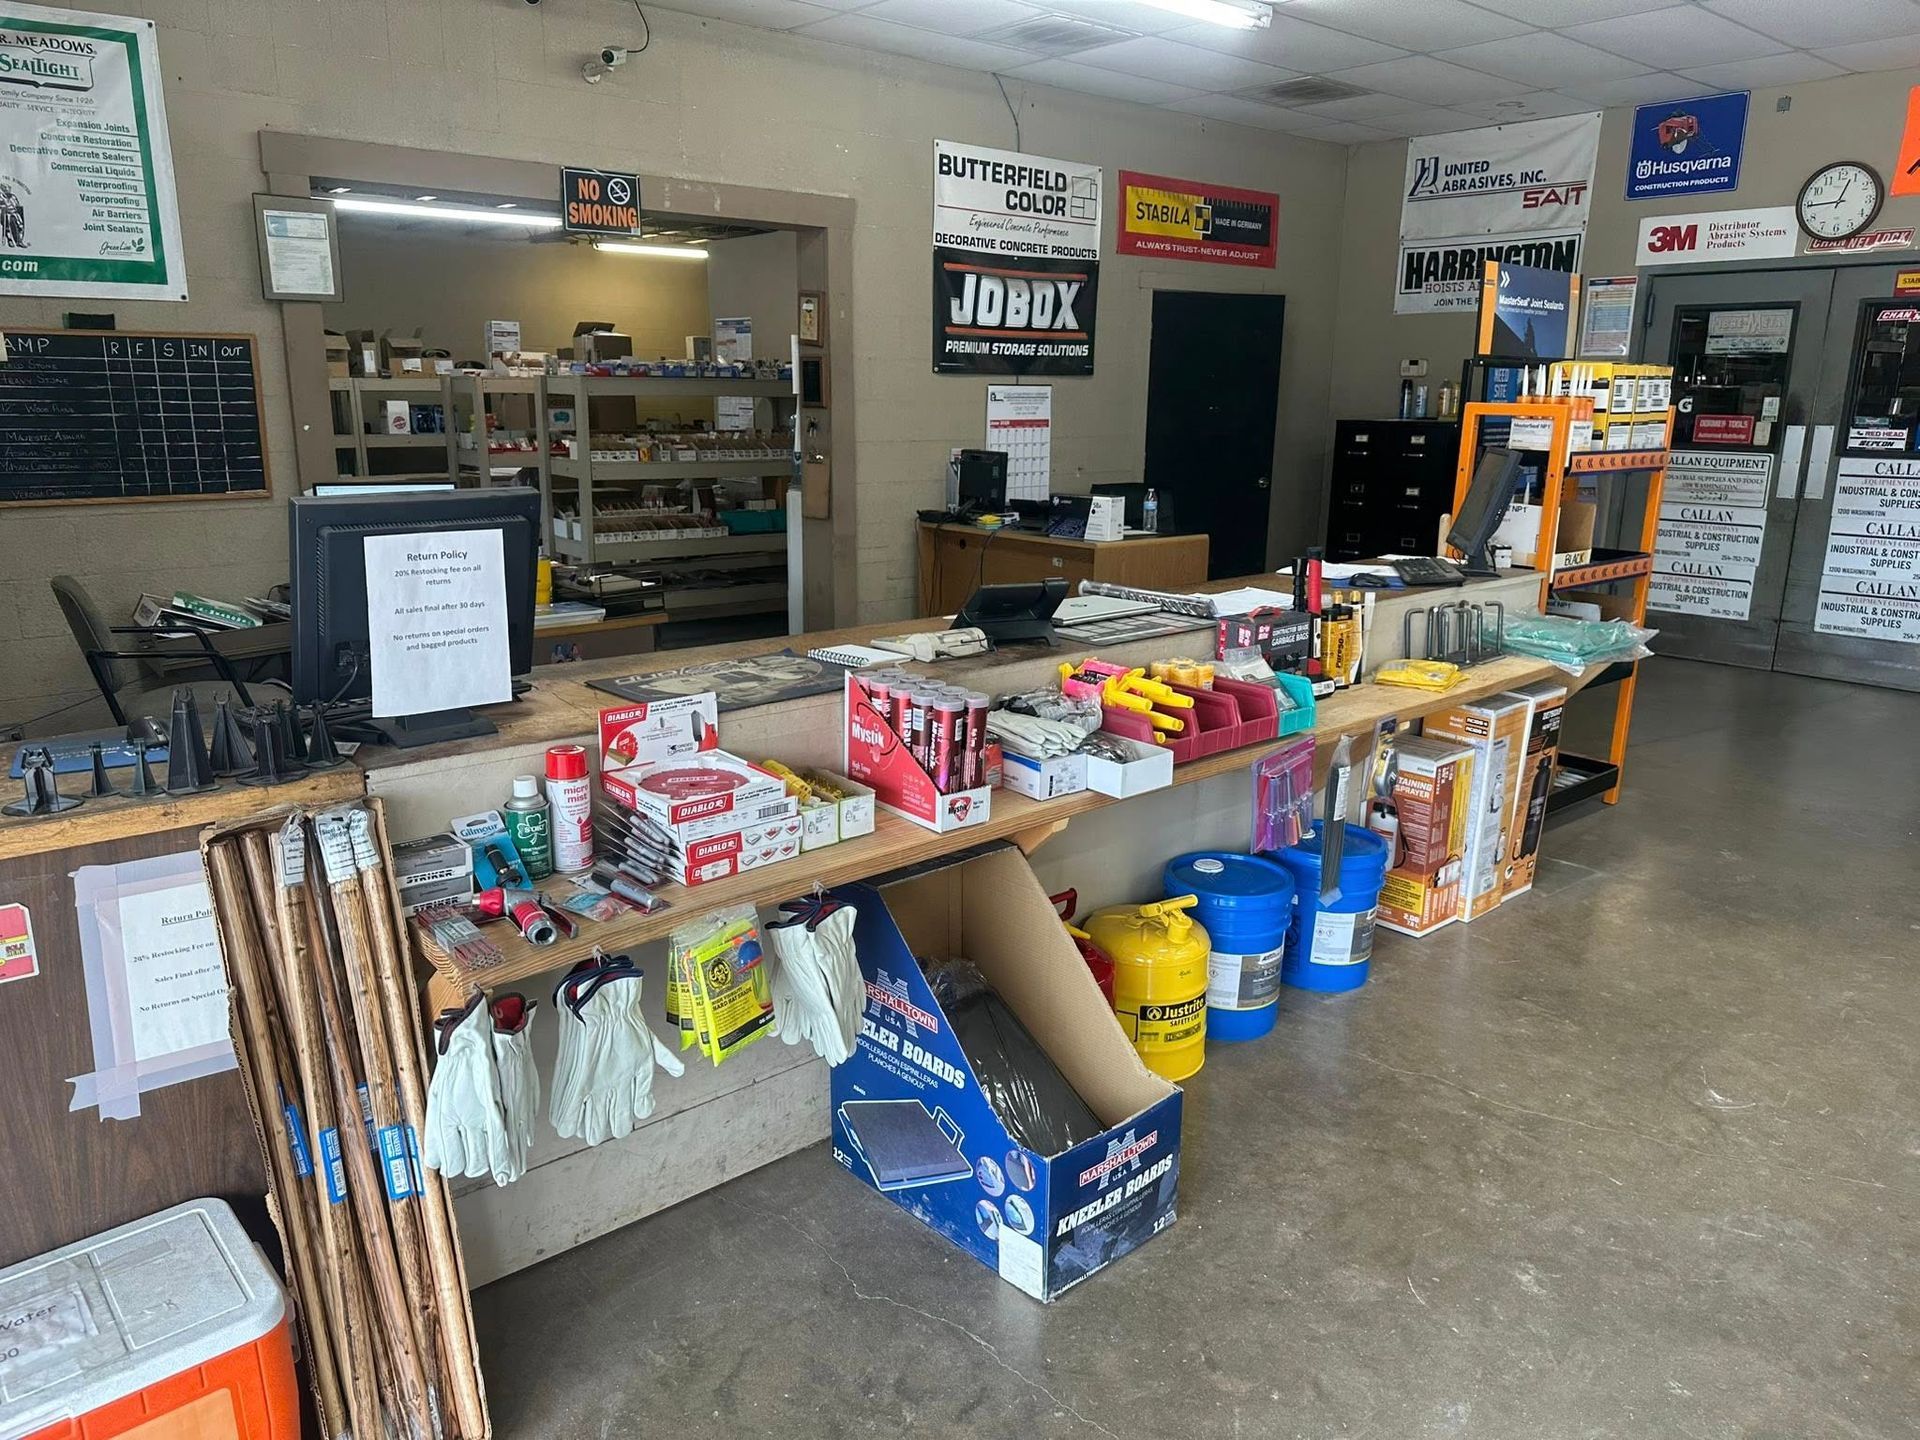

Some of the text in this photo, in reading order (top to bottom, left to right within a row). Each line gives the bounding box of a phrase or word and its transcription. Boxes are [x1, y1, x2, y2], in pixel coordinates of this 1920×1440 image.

[16, 36, 93, 54] MEADOWS
[21, 91, 54, 101] Company
[55, 94, 73, 103] Since
[56, 118, 130, 133] Expansion Joints
[40, 132, 132, 148] Concrete Restoration
[9, 144, 134, 163] Decorative Concrete Sealers
[50, 162, 136, 177] Commercial Liquids
[939, 153, 1067, 193] BUTTERFIELD
[1444, 160, 1490, 177] UNITED
[1652, 156, 1731, 175] Husqvarna
[77, 178, 138, 192] Waterproofing
[1442, 169, 1547, 193] ABRASIVES, INC.
[1635, 176, 1729, 192] CONSTRUCTION PRODUCTS
[578, 178, 599, 200] NO
[79, 193, 141, 207] Vaporproofing
[1006, 189, 1066, 217] COLOR
[1523, 186, 1588, 209] SAIT
[92, 209, 143, 220] Air Barriers
[569, 202, 638, 228] SMOKING
[1136, 202, 1190, 225] STABILA
[83, 223, 144, 234] Joint Sealants
[969, 214, 1070, 239] Engineered Concrete Performance
[1215, 217, 1262, 230] MADE IN GERMANY
[1709, 221, 1761, 232] Distributor
[1648, 225, 1698, 253] 3M
[1708, 228, 1787, 240] Abrasive Systems
[935, 232, 1097, 259] DECORATIVE CONCRETE PRODUCTS
[1136, 240, 1171, 251] ALWAYS
[1229, 251, 1259, 260] ADJUST
[1707, 239, 1746, 250] Products
[1425, 282, 1464, 294] HOISTS
[950, 273, 1080, 330] JOBOX
[1434, 298, 1453, 307] JOIN
[1456, 298, 1472, 306] THE
[1530, 298, 1564, 310] Joint Sealants
[110, 342, 244, 357] R F S IN OUT
[945, 340, 1089, 357] PREMIUM STORAGE SOLUTIONS
[1704, 458, 1766, 469] EQUIPMENT
[1839, 486, 1897, 497] INDUSTRIAL &
[1879, 499, 1920, 509] SUPPLIES
[1680, 508, 1734, 521] CALLAN
[1694, 531, 1760, 545] & CONSTRUCTION
[1685, 541, 1720, 551] SUPPLIES
[1831, 544, 1888, 557] INDUSTRIAL &
[407, 550, 468, 562] Return Policy
[1565, 552, 1584, 566] BLACK
[411, 567, 448, 577] Restocking
[473, 564, 482, 572] all
[1671, 561, 1724, 576] CALLAN
[1842, 567, 1876, 576] WASHINGTON
[1870, 558, 1911, 570] SUPPLIES
[426, 578, 452, 586] returns
[1856, 580, 1918, 597] CALLAN
[1684, 584, 1748, 599] & CONSTRUCTION
[1675, 594, 1710, 605] SUPPLIES
[394, 607, 405, 615] All
[406, 606, 423, 614] sales
[424, 603, 440, 612] final
[441, 602, 457, 611] after
[469, 601, 485, 610] days
[1821, 602, 1877, 615] INDUSTRIAL &
[1861, 616, 1902, 629] SUPPLIES
[393, 633, 403, 641] No
[404, 631, 430, 640] returns
[442, 627, 466, 638] special
[467, 625, 489, 634] orders
[1272, 632, 1309, 646] GARBAGE BAGS
[406, 638, 478, 651] and bagged products
[607, 711, 635, 722] DIABLO
[852, 722, 884, 749] Mystik
[564, 784, 588, 795] micro
[568, 794, 587, 803] mist
[680, 801, 715, 816] DIABLO
[460, 823, 499, 837] Gilmour
[699, 842, 728, 856] DIABLO
[407, 869, 453, 884] STRIKER
[413, 896, 458, 912] STRIKER
[161, 914, 193, 926] Return
[133, 943, 204, 963] 20% Restocking Fee
[154, 964, 221, 984] Sales Final after 30
[139, 990, 217, 1013] No Returns Special
[713, 996, 738, 1011] HARD HAT
[1163, 998, 1204, 1019] Justrite
[1170, 1017, 1190, 1027] SAFETY
[868, 1053, 925, 1090] PLANCHES GENOUX
[902, 1039, 966, 1089] BOARDS
[900, 1061, 939, 1088] ESPINILLERAS
[1081, 1132, 1156, 1183] MARSHALLTOWN
[1057, 1187, 1122, 1237] KNEELER
[1125, 1154, 1174, 1198] BOARDS
[1153, 1218, 1165, 1234] 12
